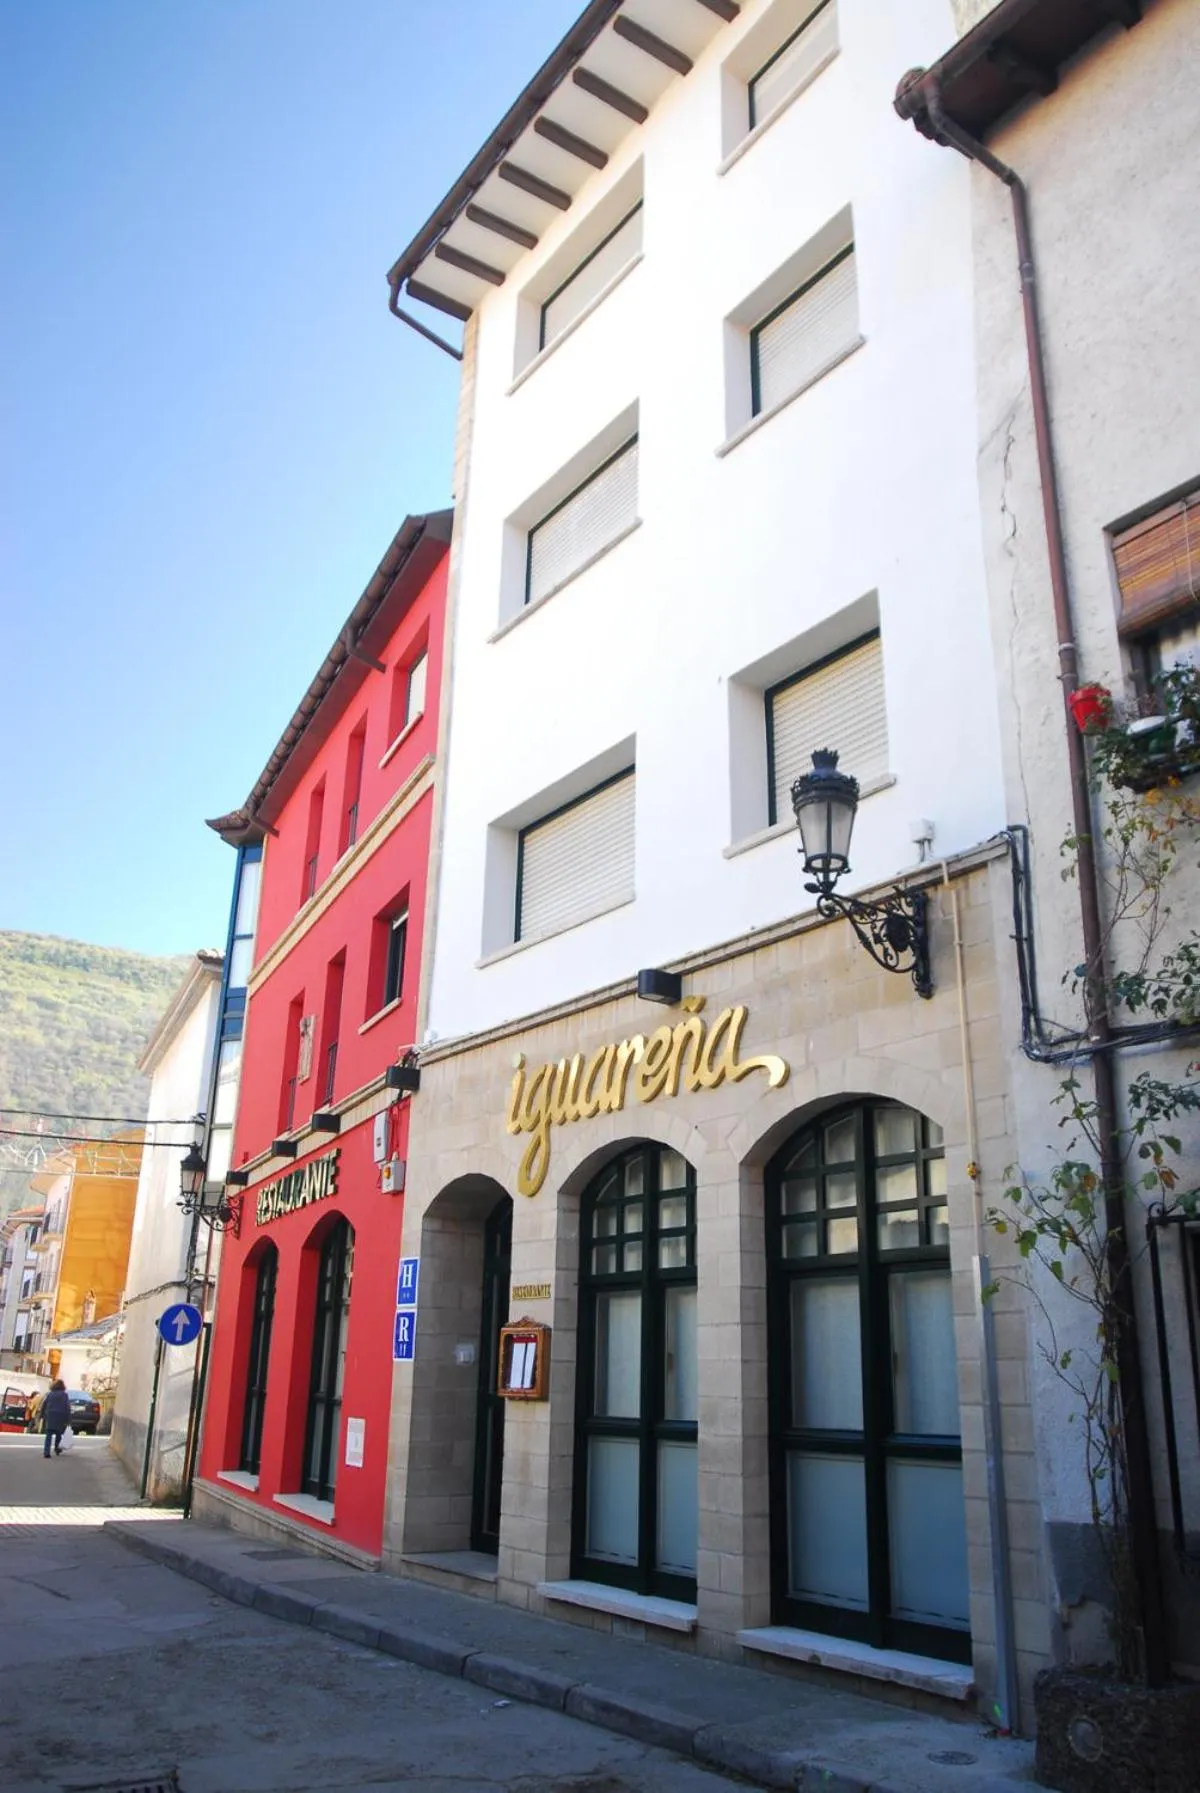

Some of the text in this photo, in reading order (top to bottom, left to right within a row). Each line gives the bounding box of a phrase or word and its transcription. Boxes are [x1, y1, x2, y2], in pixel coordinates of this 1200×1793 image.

[506, 995, 791, 1197] iguareña
[256, 1148, 341, 1226] RESTAURANTE
[402, 1264, 413, 1288] H
[398, 1317, 409, 1342] R
